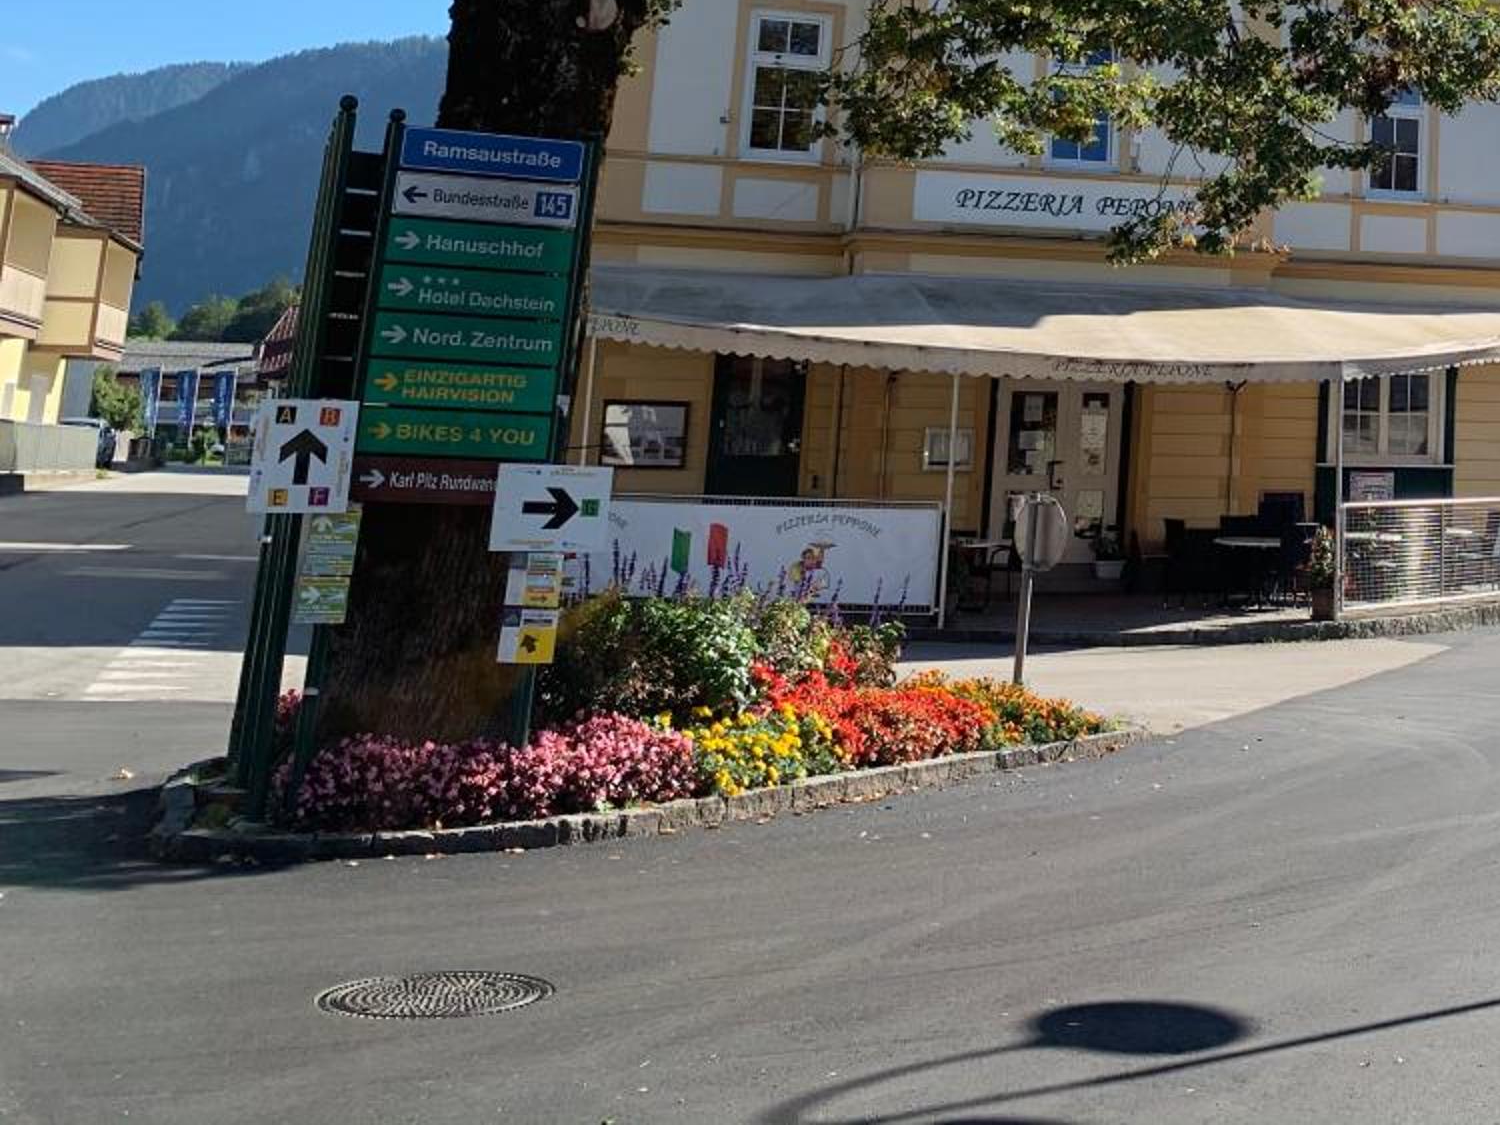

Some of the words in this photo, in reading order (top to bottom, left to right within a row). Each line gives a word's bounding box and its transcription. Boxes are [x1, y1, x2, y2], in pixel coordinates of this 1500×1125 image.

[423, 139, 562, 168] Ramsaustraße
[433, 188, 529, 211] Bundesstraße
[540, 193, 568, 217] 145
[956, 188, 1085, 217] PIZZERIA
[426, 234, 545, 259] Hanuschhof
[418, 287, 466, 307] Hotel
[469, 291, 556, 313] Dachstein
[412, 327, 467, 347] Nord.
[469, 331, 553, 352] Zentrum
[403, 369, 528, 389] EINZIGARTIG
[401, 386, 515, 404] HAIRVISION
[279, 407, 292, 423] A
[396, 423, 464, 442] BIKES
[469, 427, 482, 443] 4
[489, 427, 536, 446] YOU
[389, 472, 416, 490] Karl
